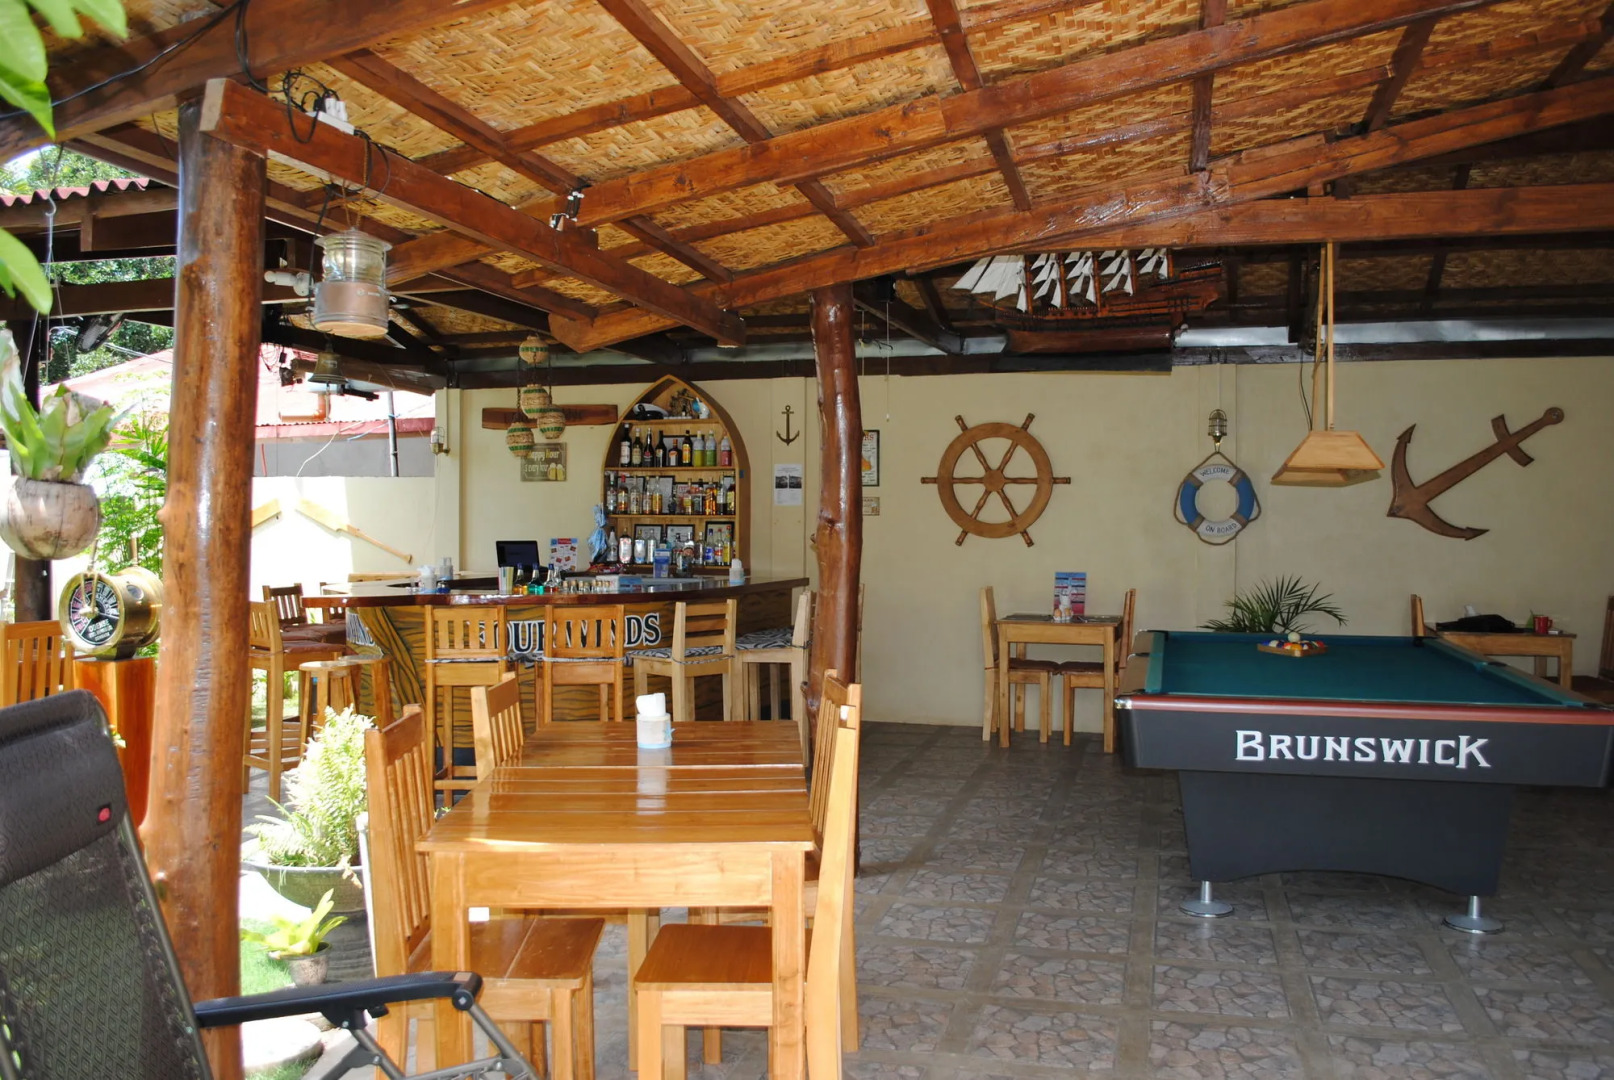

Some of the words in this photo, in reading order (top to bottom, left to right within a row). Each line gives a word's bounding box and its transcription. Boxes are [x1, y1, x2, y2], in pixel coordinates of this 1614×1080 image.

[1200, 467, 1230, 476] WELCOME
[1205, 524, 1215, 533] ON
[1216, 522, 1237, 533] BOARD
[562, 613, 662, 649] WIDS
[1235, 730, 1492, 768] BRUNSWICK
